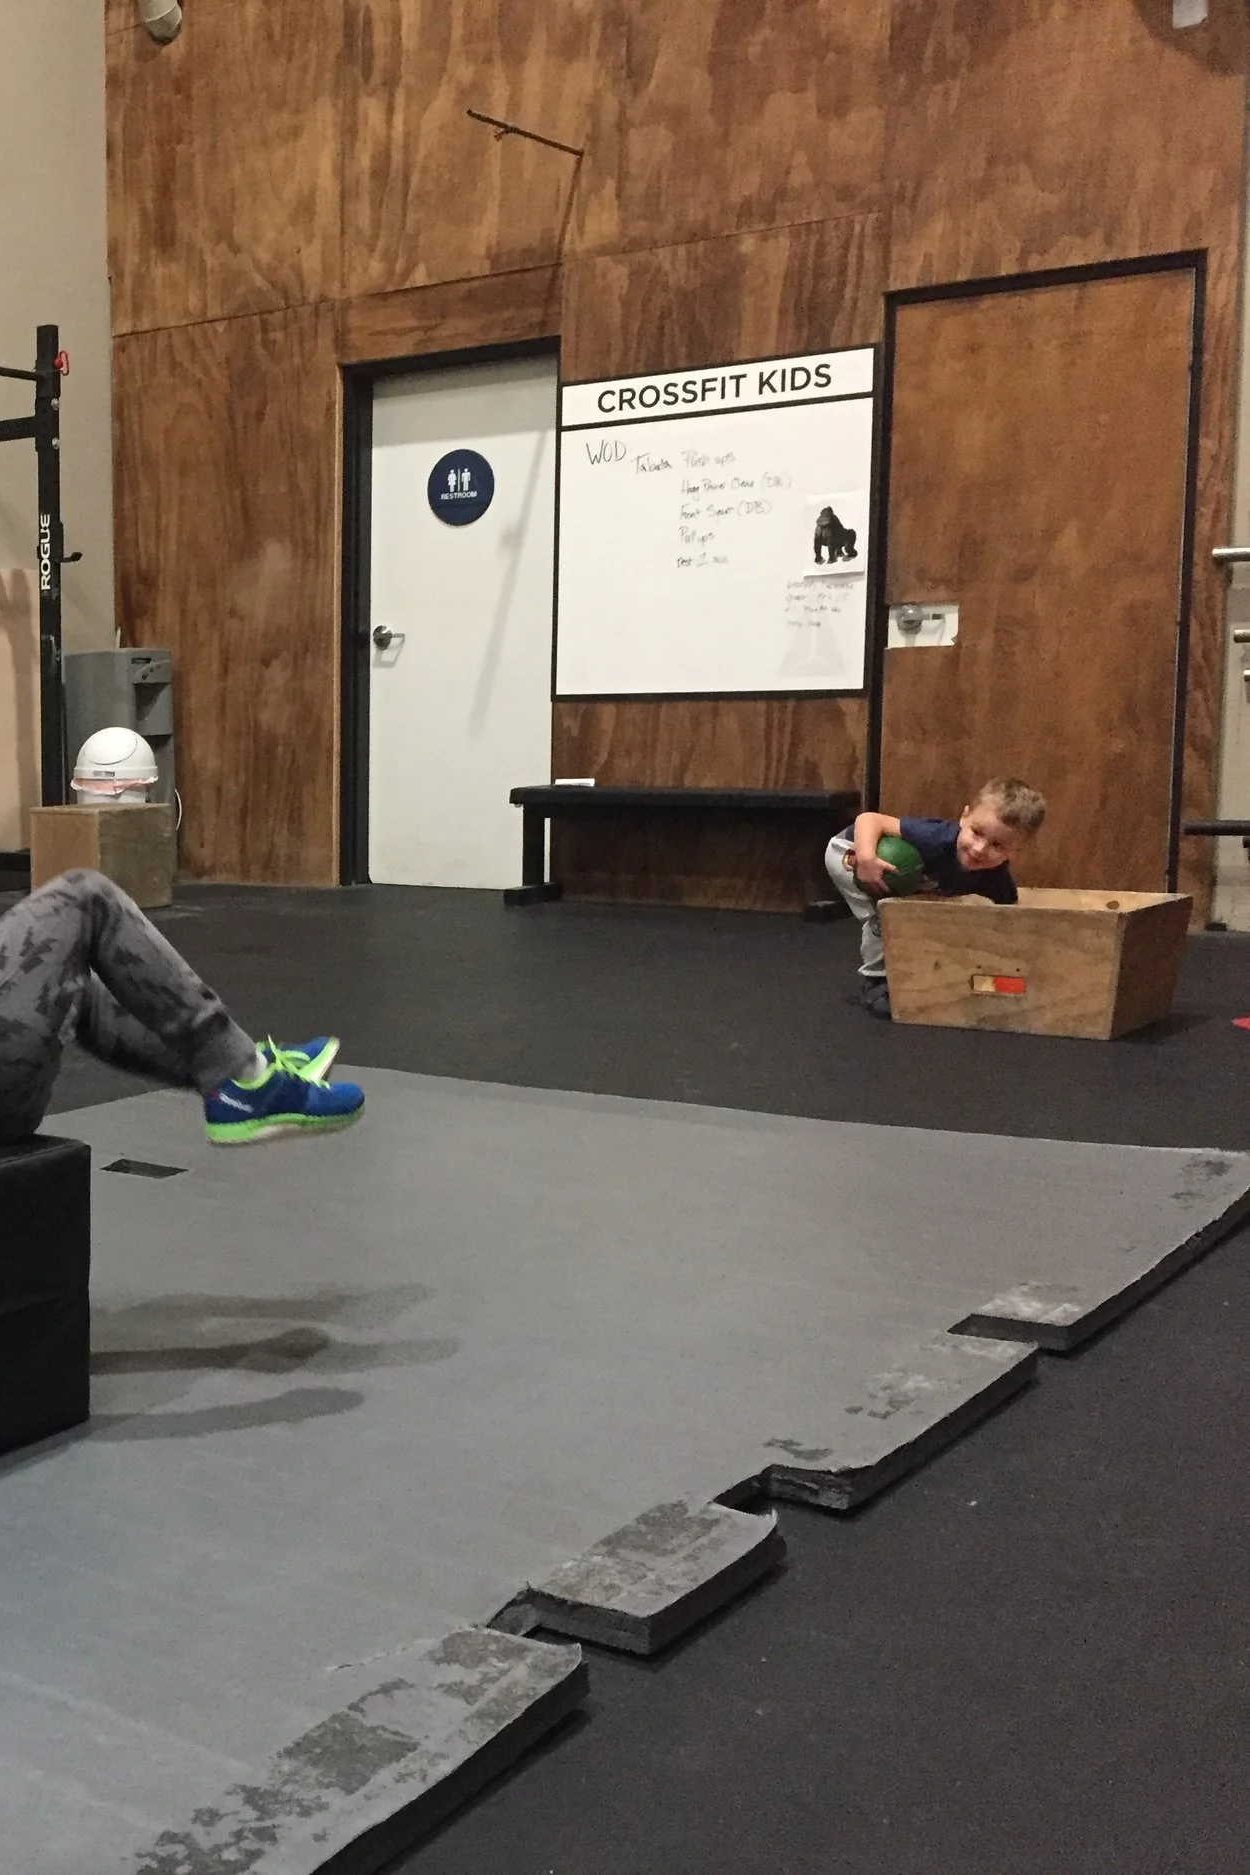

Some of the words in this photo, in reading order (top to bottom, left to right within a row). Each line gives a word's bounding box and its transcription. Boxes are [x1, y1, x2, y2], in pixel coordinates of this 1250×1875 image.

[597, 373, 747, 413] CROSSFIT
[757, 363, 832, 395] KIDS
[585, 440, 627, 465] WOD
[440, 491, 478, 500] RESTROOM
[40, 513, 51, 591] ROGUE
